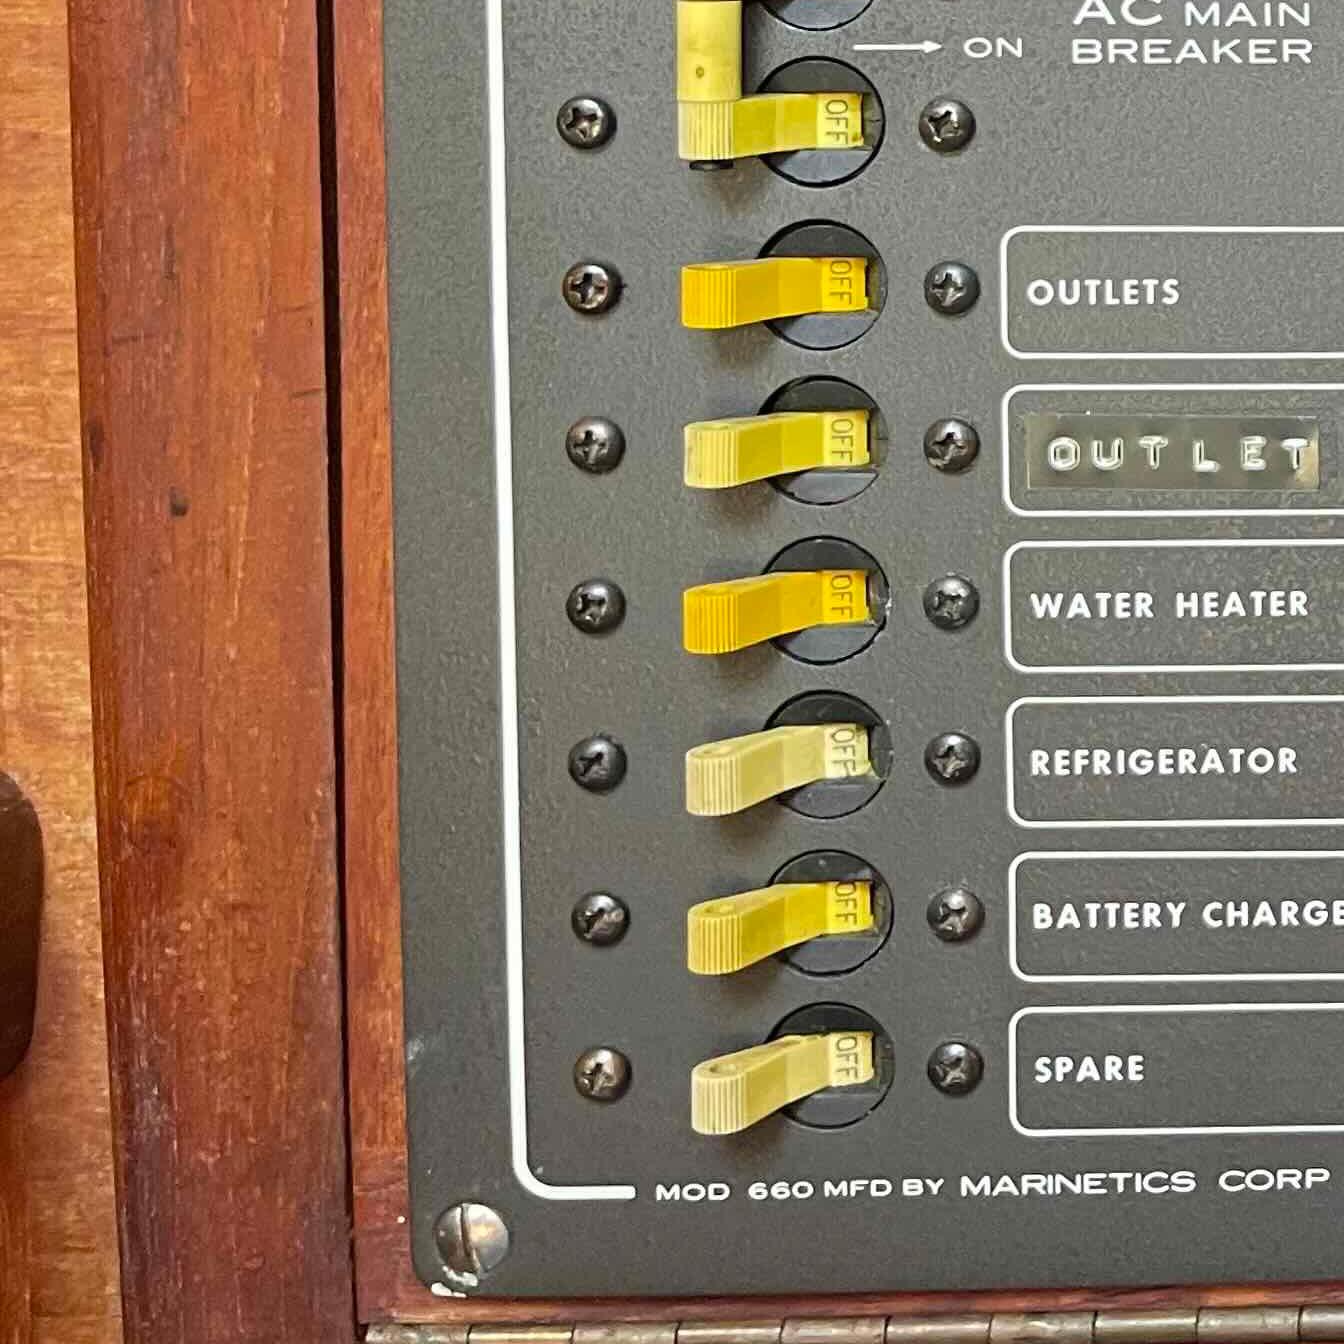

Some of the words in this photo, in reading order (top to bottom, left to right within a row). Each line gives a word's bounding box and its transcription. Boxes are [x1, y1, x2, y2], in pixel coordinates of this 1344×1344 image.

[1184, 2, 1311, 26] MAIN
[964, 38, 1022, 59] ON
[1071, 40, 1313, 64] BREAKER
[825, 99, 849, 145] OFF
[828, 260, 853, 306] OFF
[1027, 278, 1180, 306] OUTLETS
[829, 418, 853, 464] OFF
[1048, 436, 1312, 472] OUTLET
[828, 572, 854, 620] OFF
[1030, 592, 1154, 620] WATER
[1175, 591, 1309, 618] HEATER
[1030, 747, 1299, 775] REFRIGERATOR
[1032, 903, 1186, 929] BATTERY
[1034, 1056, 1145, 1082] SPARE
[654, 1182, 730, 1201] MOD
[748, 1180, 813, 1199] 660
[823, 1178, 892, 1198] MFD
[903, 1176, 945, 1196] BY
[960, 1173, 1196, 1195] MARINETICS
[1219, 1168, 1330, 1191] CORP
